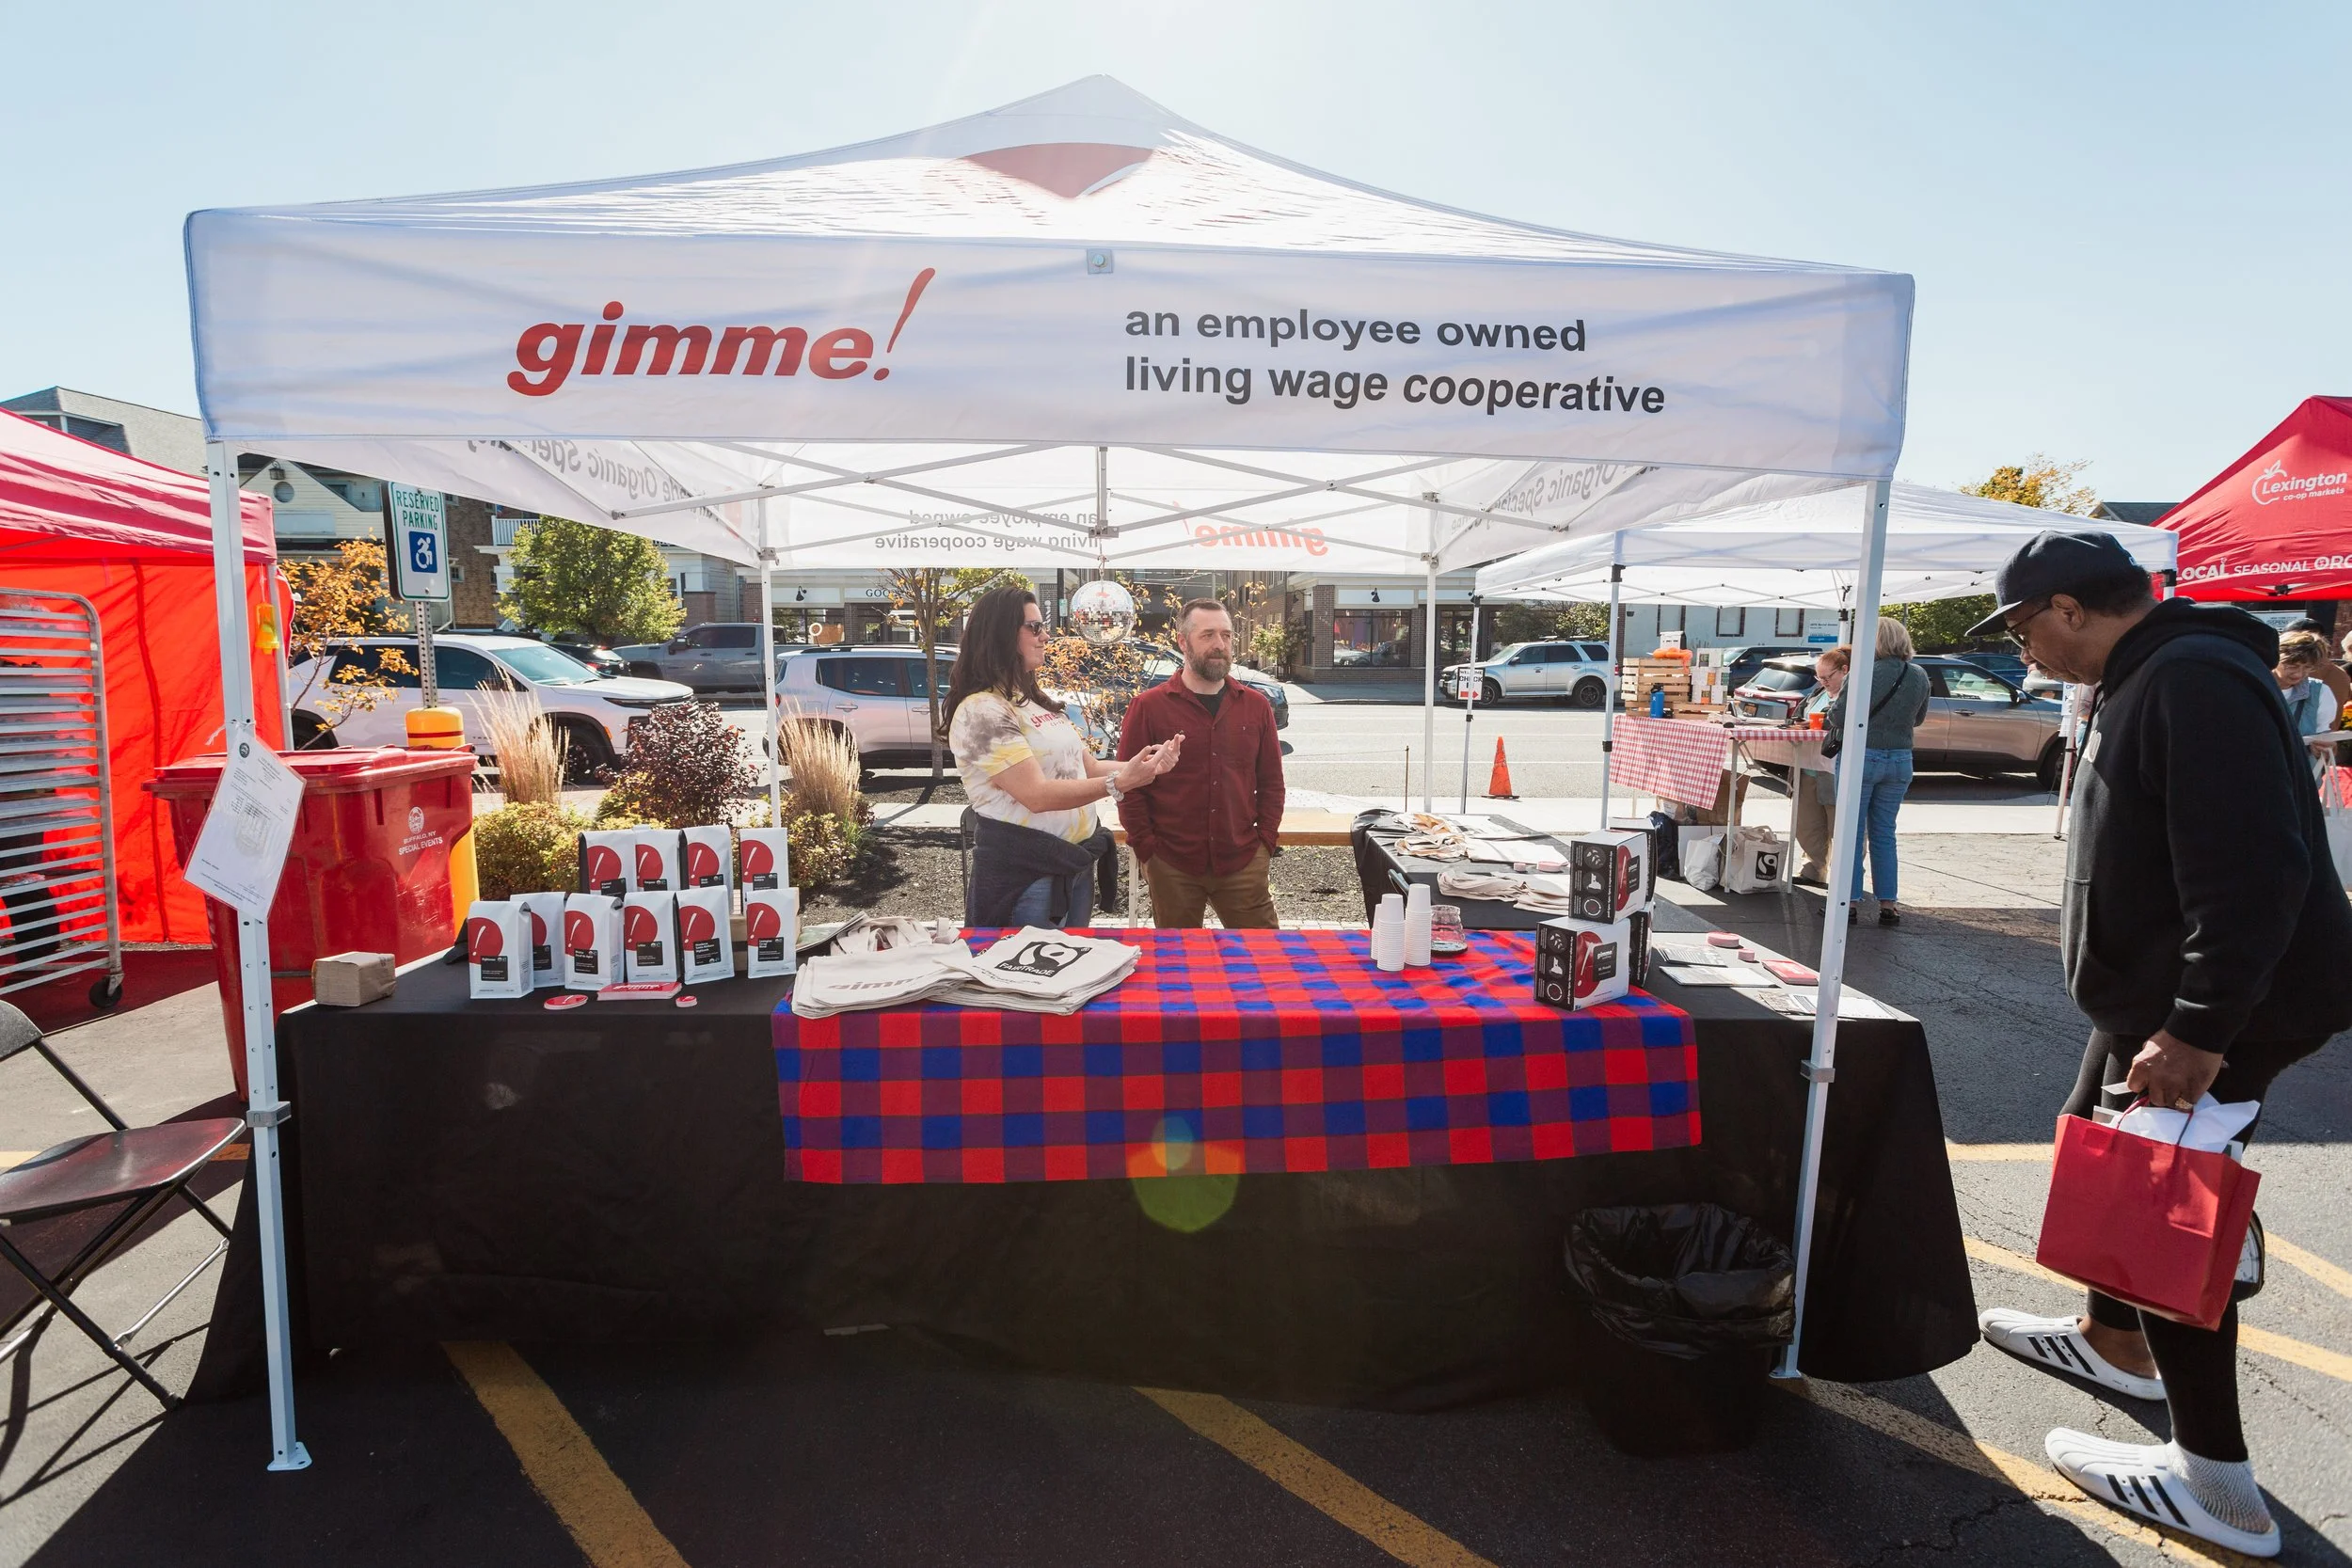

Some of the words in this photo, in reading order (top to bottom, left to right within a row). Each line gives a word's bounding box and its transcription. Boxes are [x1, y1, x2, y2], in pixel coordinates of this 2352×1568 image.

[507, 267, 936, 396] gimme!
[1125, 310, 1180, 337] an
[1197, 309, 1422, 351] employee
[1437, 319, 1586, 352] owned
[1125, 356, 1252, 404] living
[1267, 368, 1388, 409] wage
[1403, 373, 1665, 416] cooperative
[2262, 471, 2348, 495] Lexington
[2309, 486, 2344, 498] markets
[396, 490, 439, 513] RESERVED
[403, 510, 438, 531] PARKING
[2176, 558, 2230, 581] OCAL
[2233, 561, 2311, 576] SEASONAL
[398, 843, 421, 856] SPECIAL
[421, 836, 444, 849] EVENTS
[998, 962, 1056, 976] FAIRTRADE
